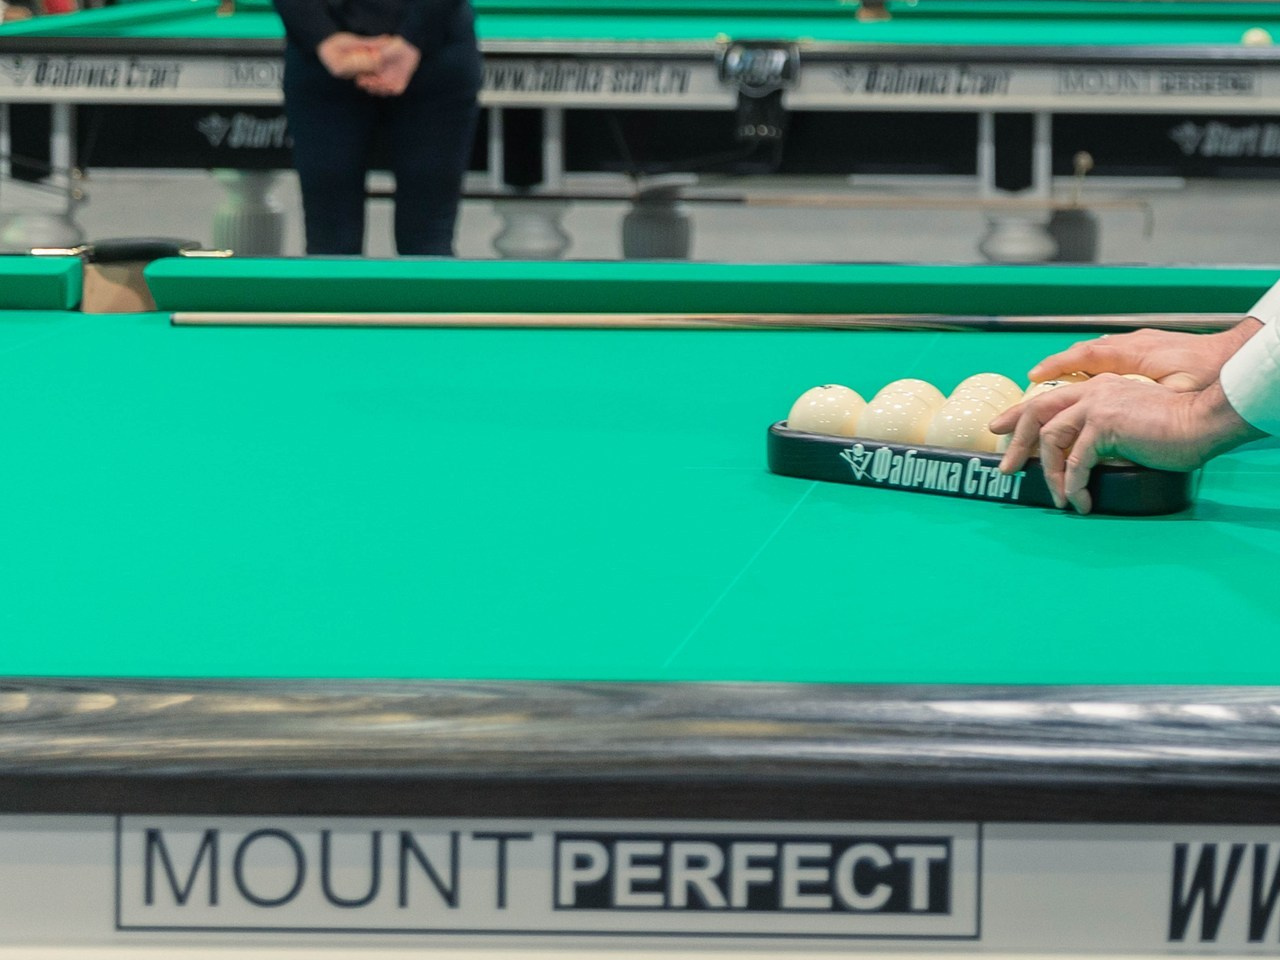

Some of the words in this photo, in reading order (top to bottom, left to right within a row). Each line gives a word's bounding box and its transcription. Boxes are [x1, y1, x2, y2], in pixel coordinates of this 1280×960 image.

[871, 446, 963, 493] Фабрика
[964, 456, 1027, 501] Старт
[142, 828, 533, 910] MOUNT
[556, 838, 949, 912] PERFECT
